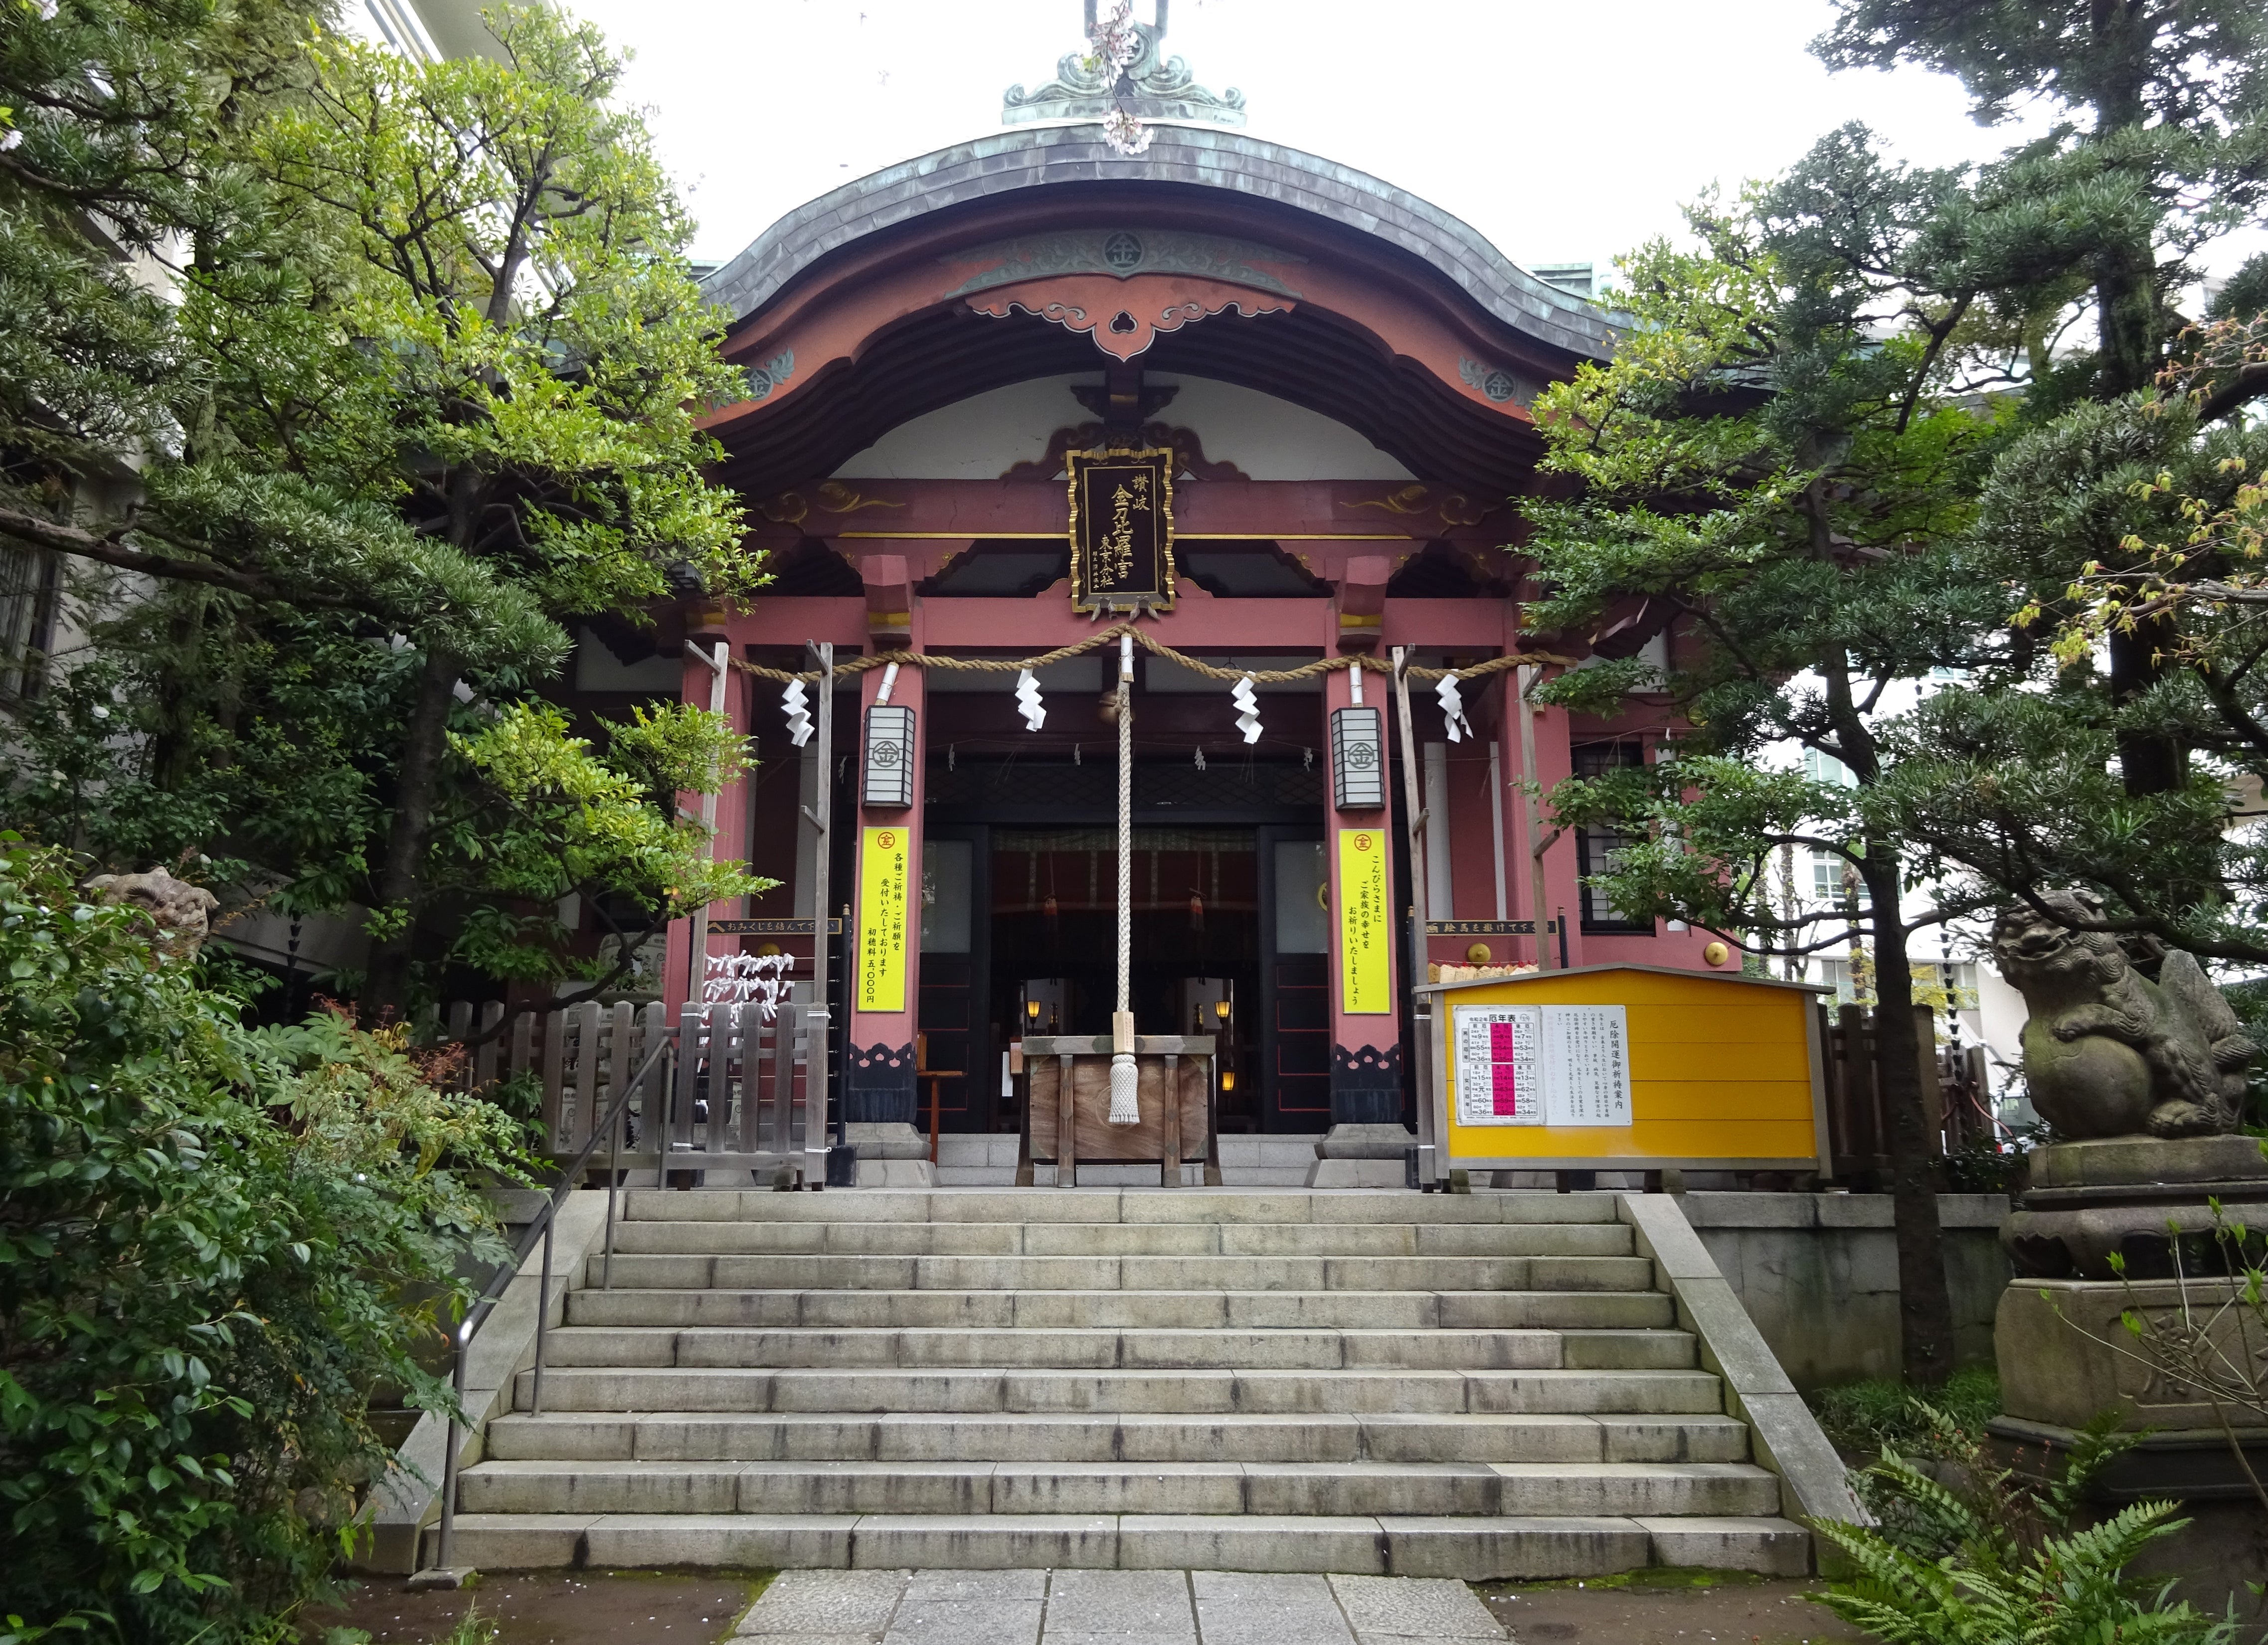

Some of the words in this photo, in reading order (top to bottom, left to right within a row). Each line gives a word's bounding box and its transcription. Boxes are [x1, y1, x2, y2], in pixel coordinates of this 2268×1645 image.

[1099, 534, 1115, 588] 東京分社
[1111, 484, 1134, 579] 金刀比羅宮
[879, 879, 890, 977] 受付いたしております
[892, 853, 903, 951] 各種ご祈祷・ご祈願を
[1360, 881, 1370, 949] ご家族の幸せを
[1372, 855, 1382, 923] こんぴらさまに
[1444, 922, 1550, 933] 絵馬を掛けて下
[1348, 906, 1360, 1005] お祈りいたしましょう
[1609, 1020, 1623, 1109] 厄除開運御祈祷案内
